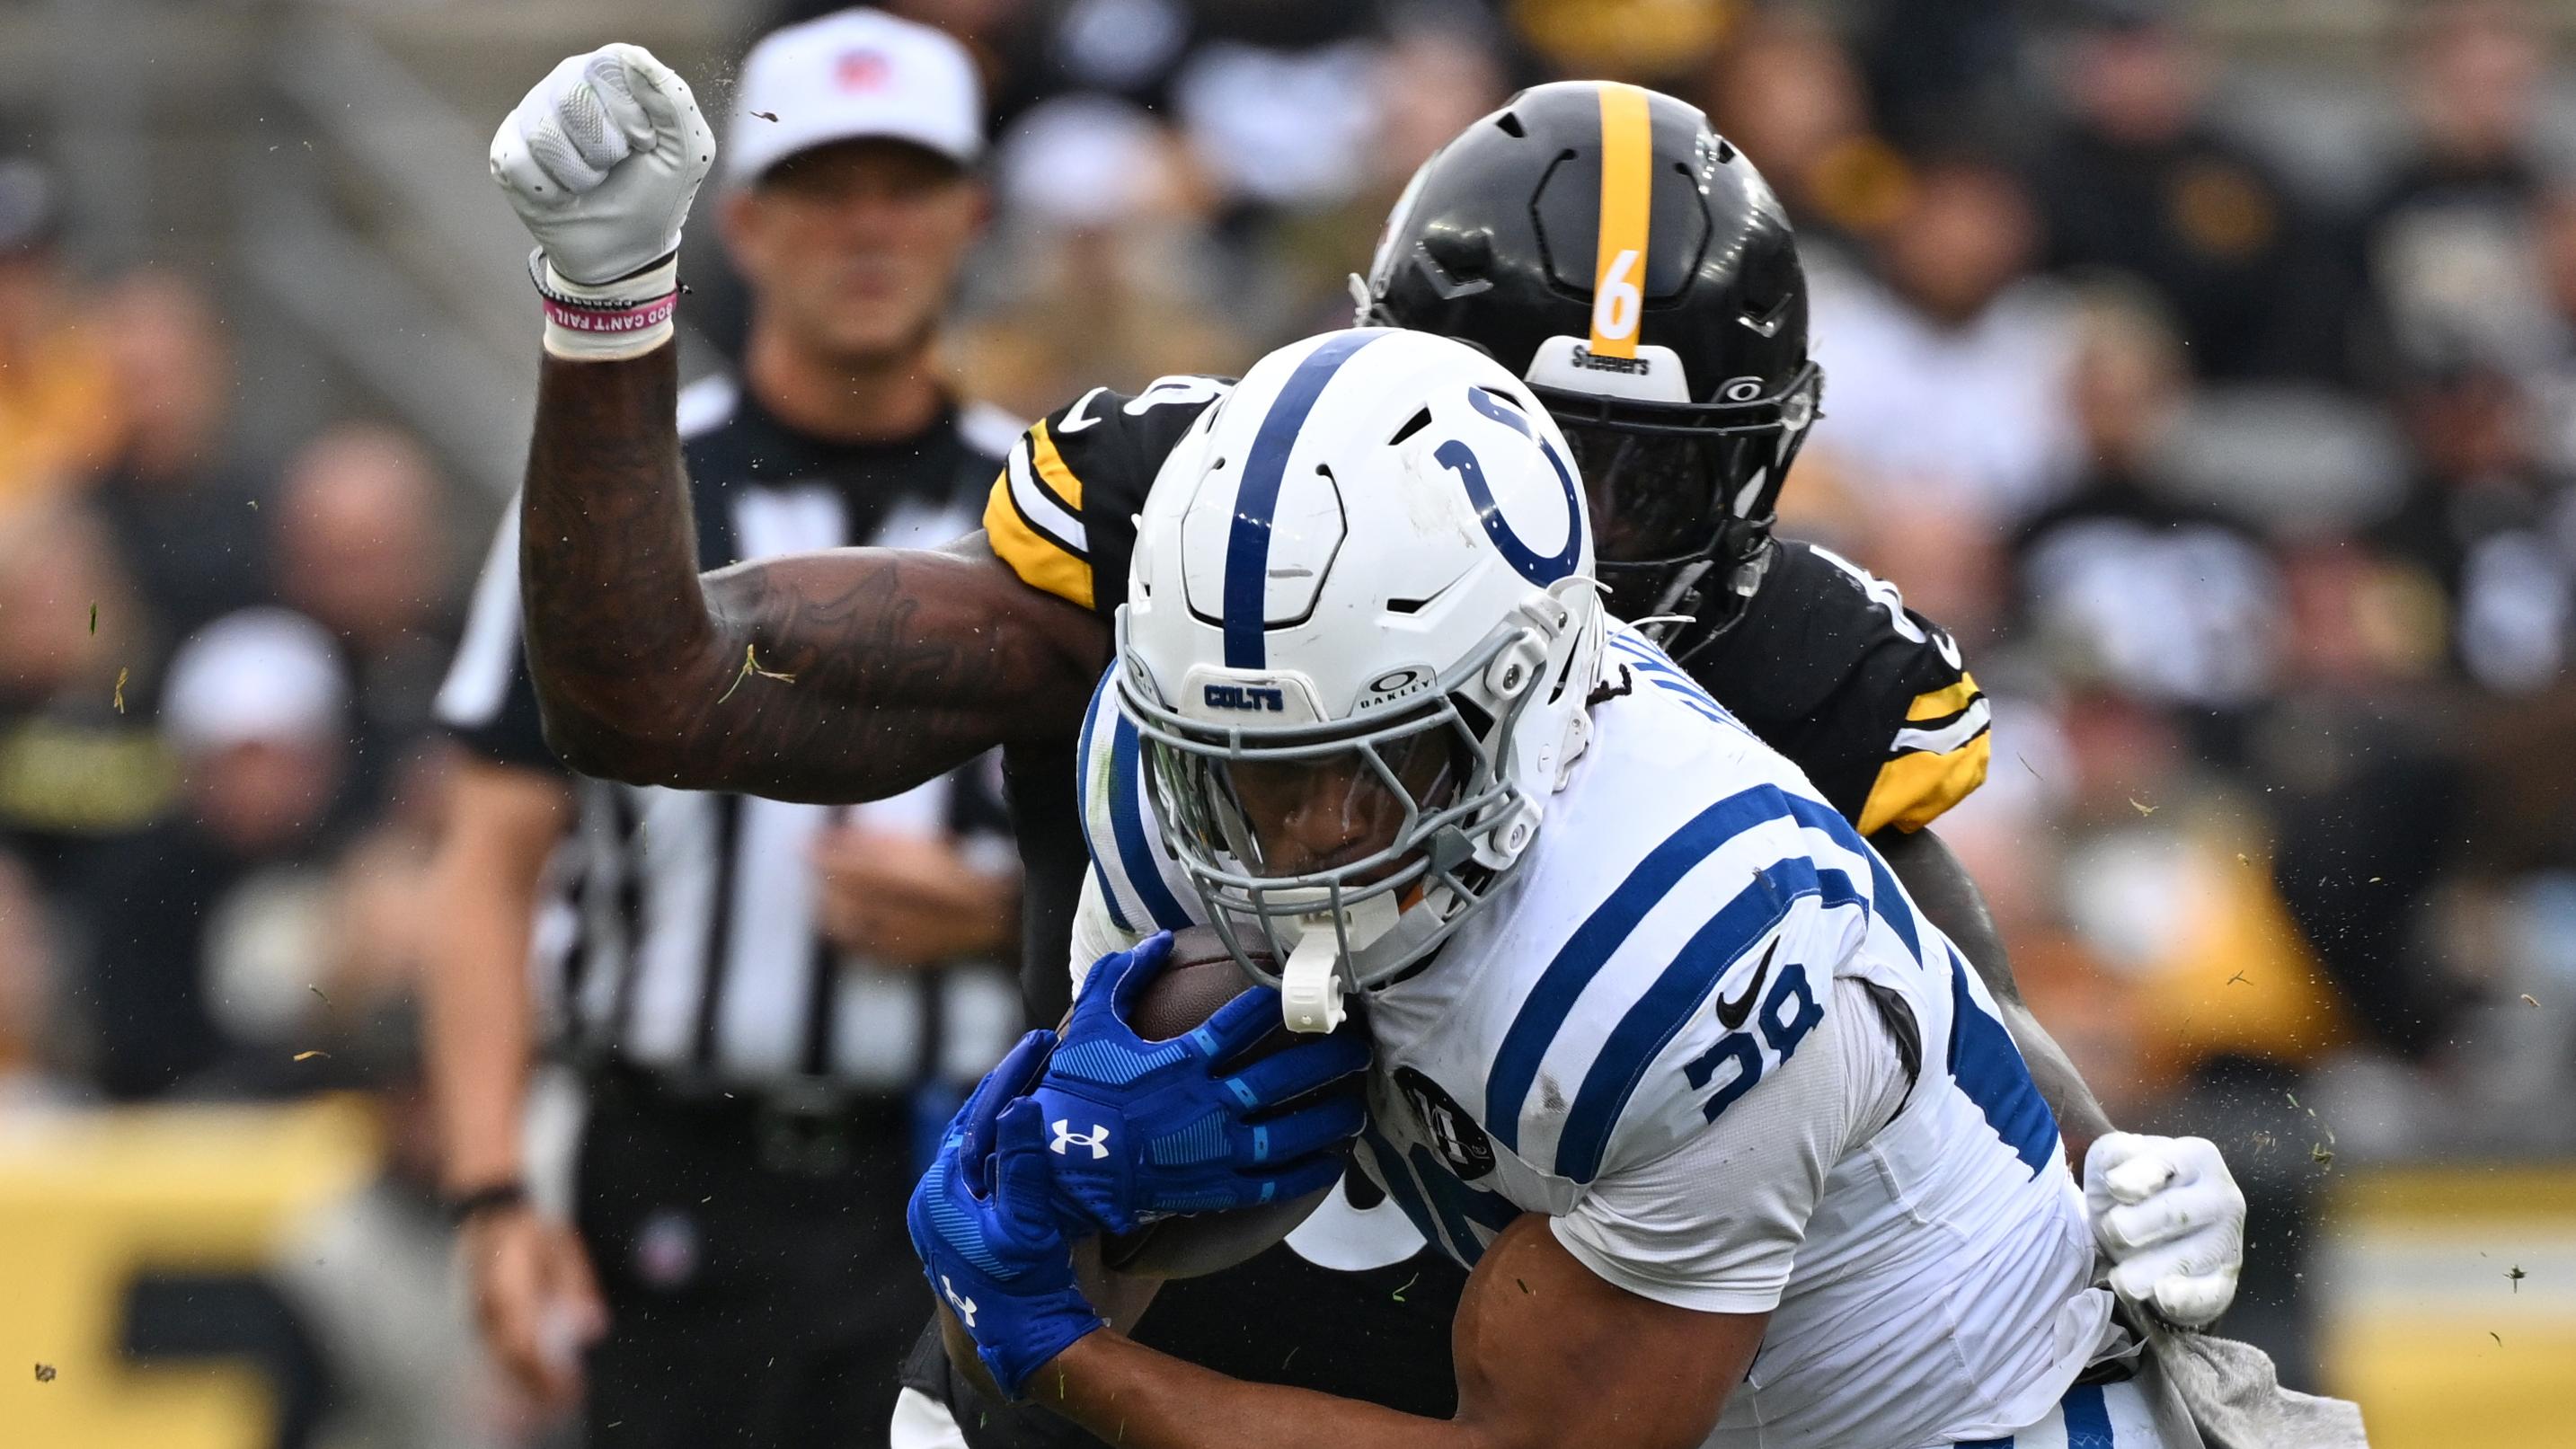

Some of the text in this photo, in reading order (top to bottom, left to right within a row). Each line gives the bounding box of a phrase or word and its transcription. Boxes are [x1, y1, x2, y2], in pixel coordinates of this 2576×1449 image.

[1593, 249, 1641, 340] 6
[593, 314, 645, 331] CAN'T
[1204, 685, 1284, 711] COLTS
[1360, 679, 1430, 709] OAKLEY
